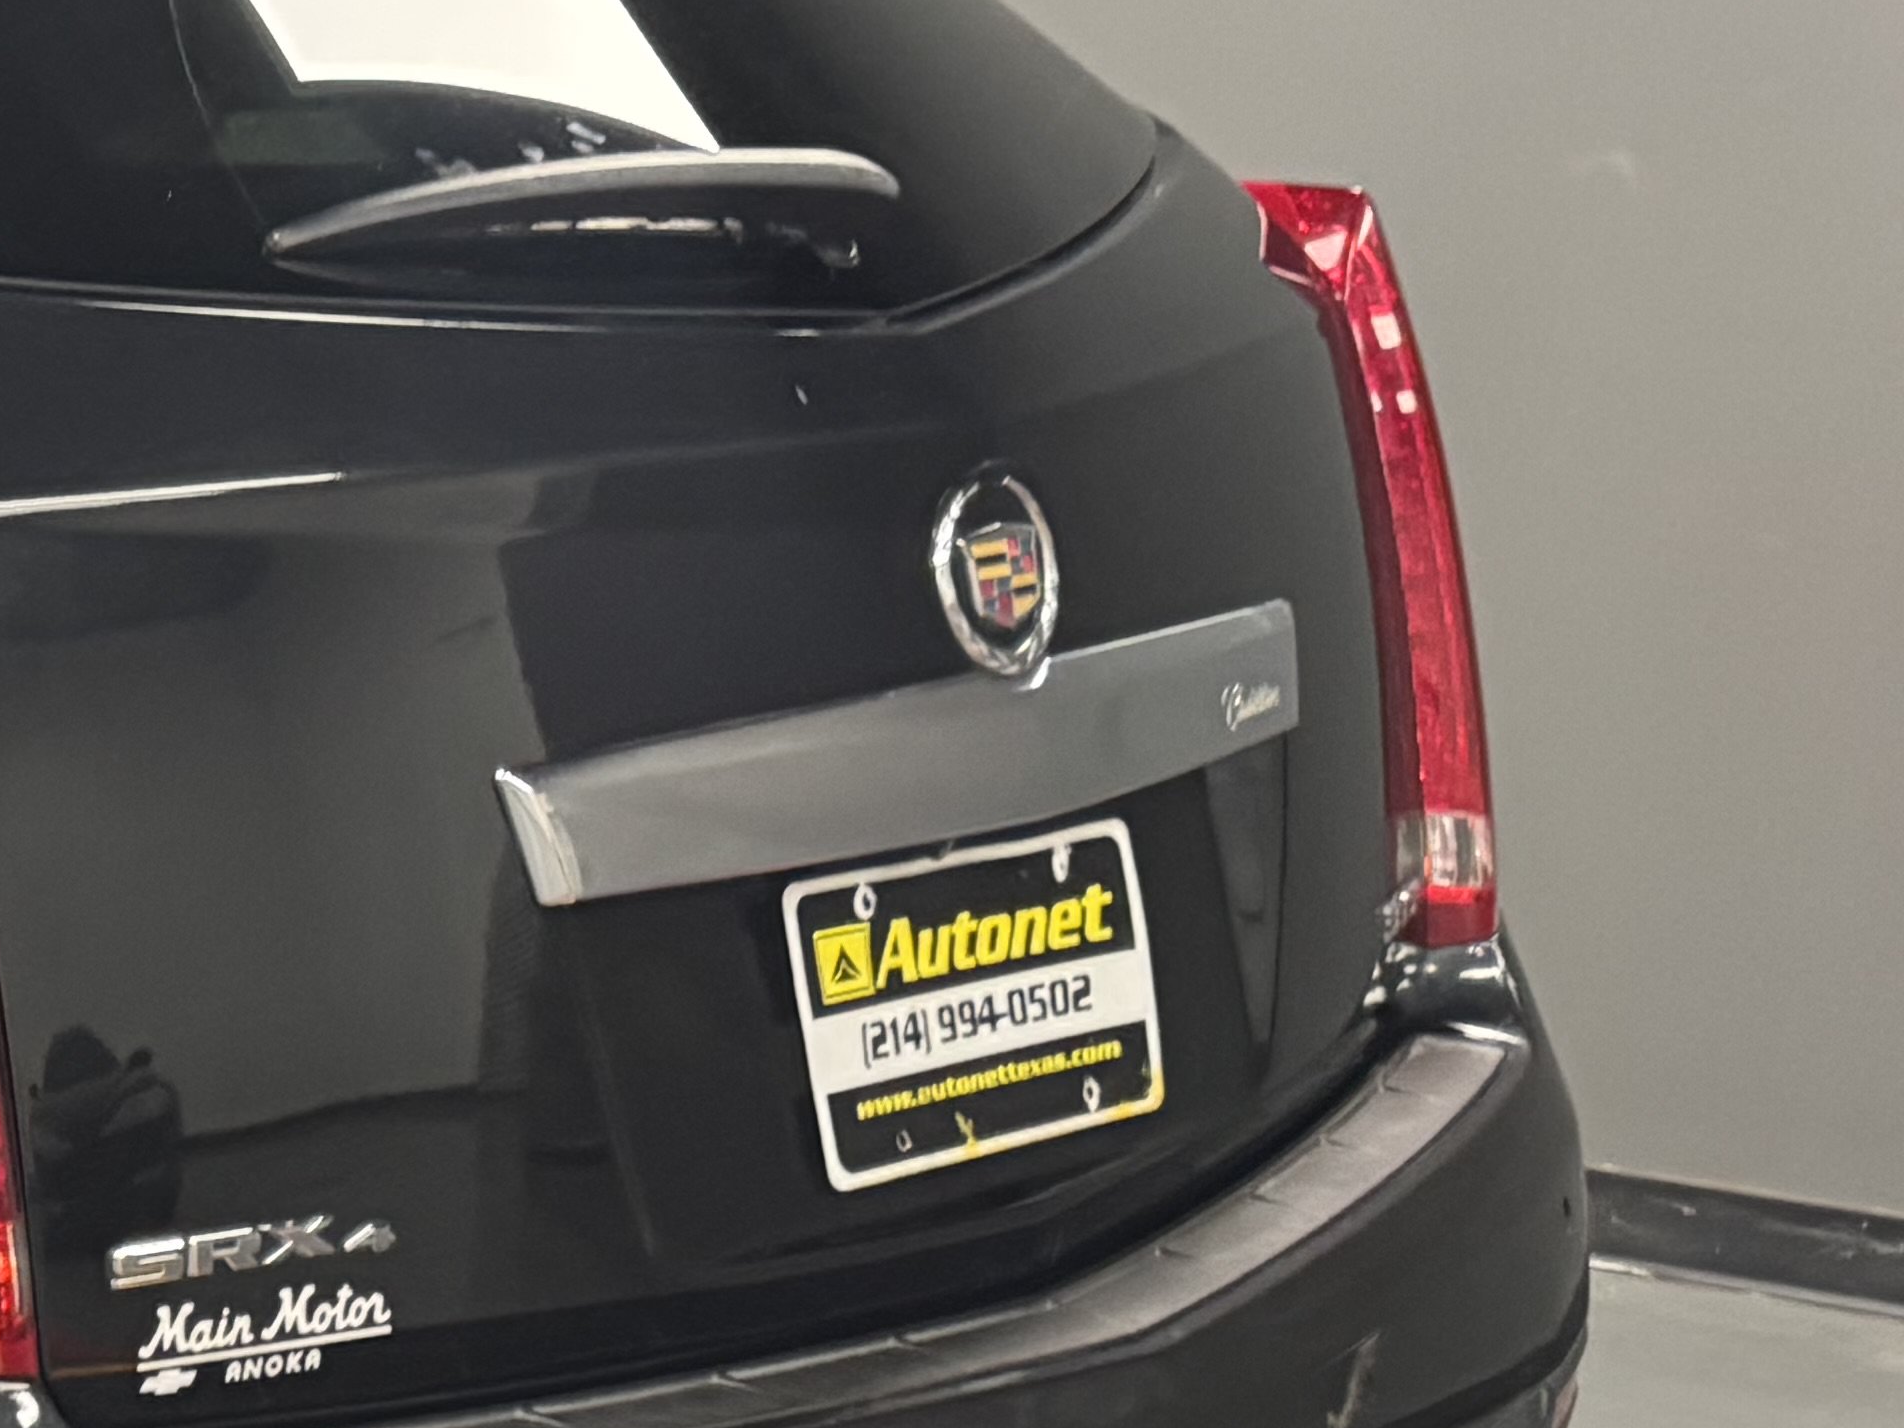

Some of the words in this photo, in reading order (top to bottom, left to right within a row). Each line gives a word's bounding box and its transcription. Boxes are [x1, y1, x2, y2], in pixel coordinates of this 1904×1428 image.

[875, 883, 1113, 989] Autonet
[861, 1009, 932, 1069] (214)
[939, 974, 1092, 1044] 994-0502
[856, 1039, 1122, 1121] www.autonettexas.com
[138, 1300, 255, 1359] Main
[260, 1283, 392, 1341] Motor
[224, 1348, 322, 1384] ANOKA
